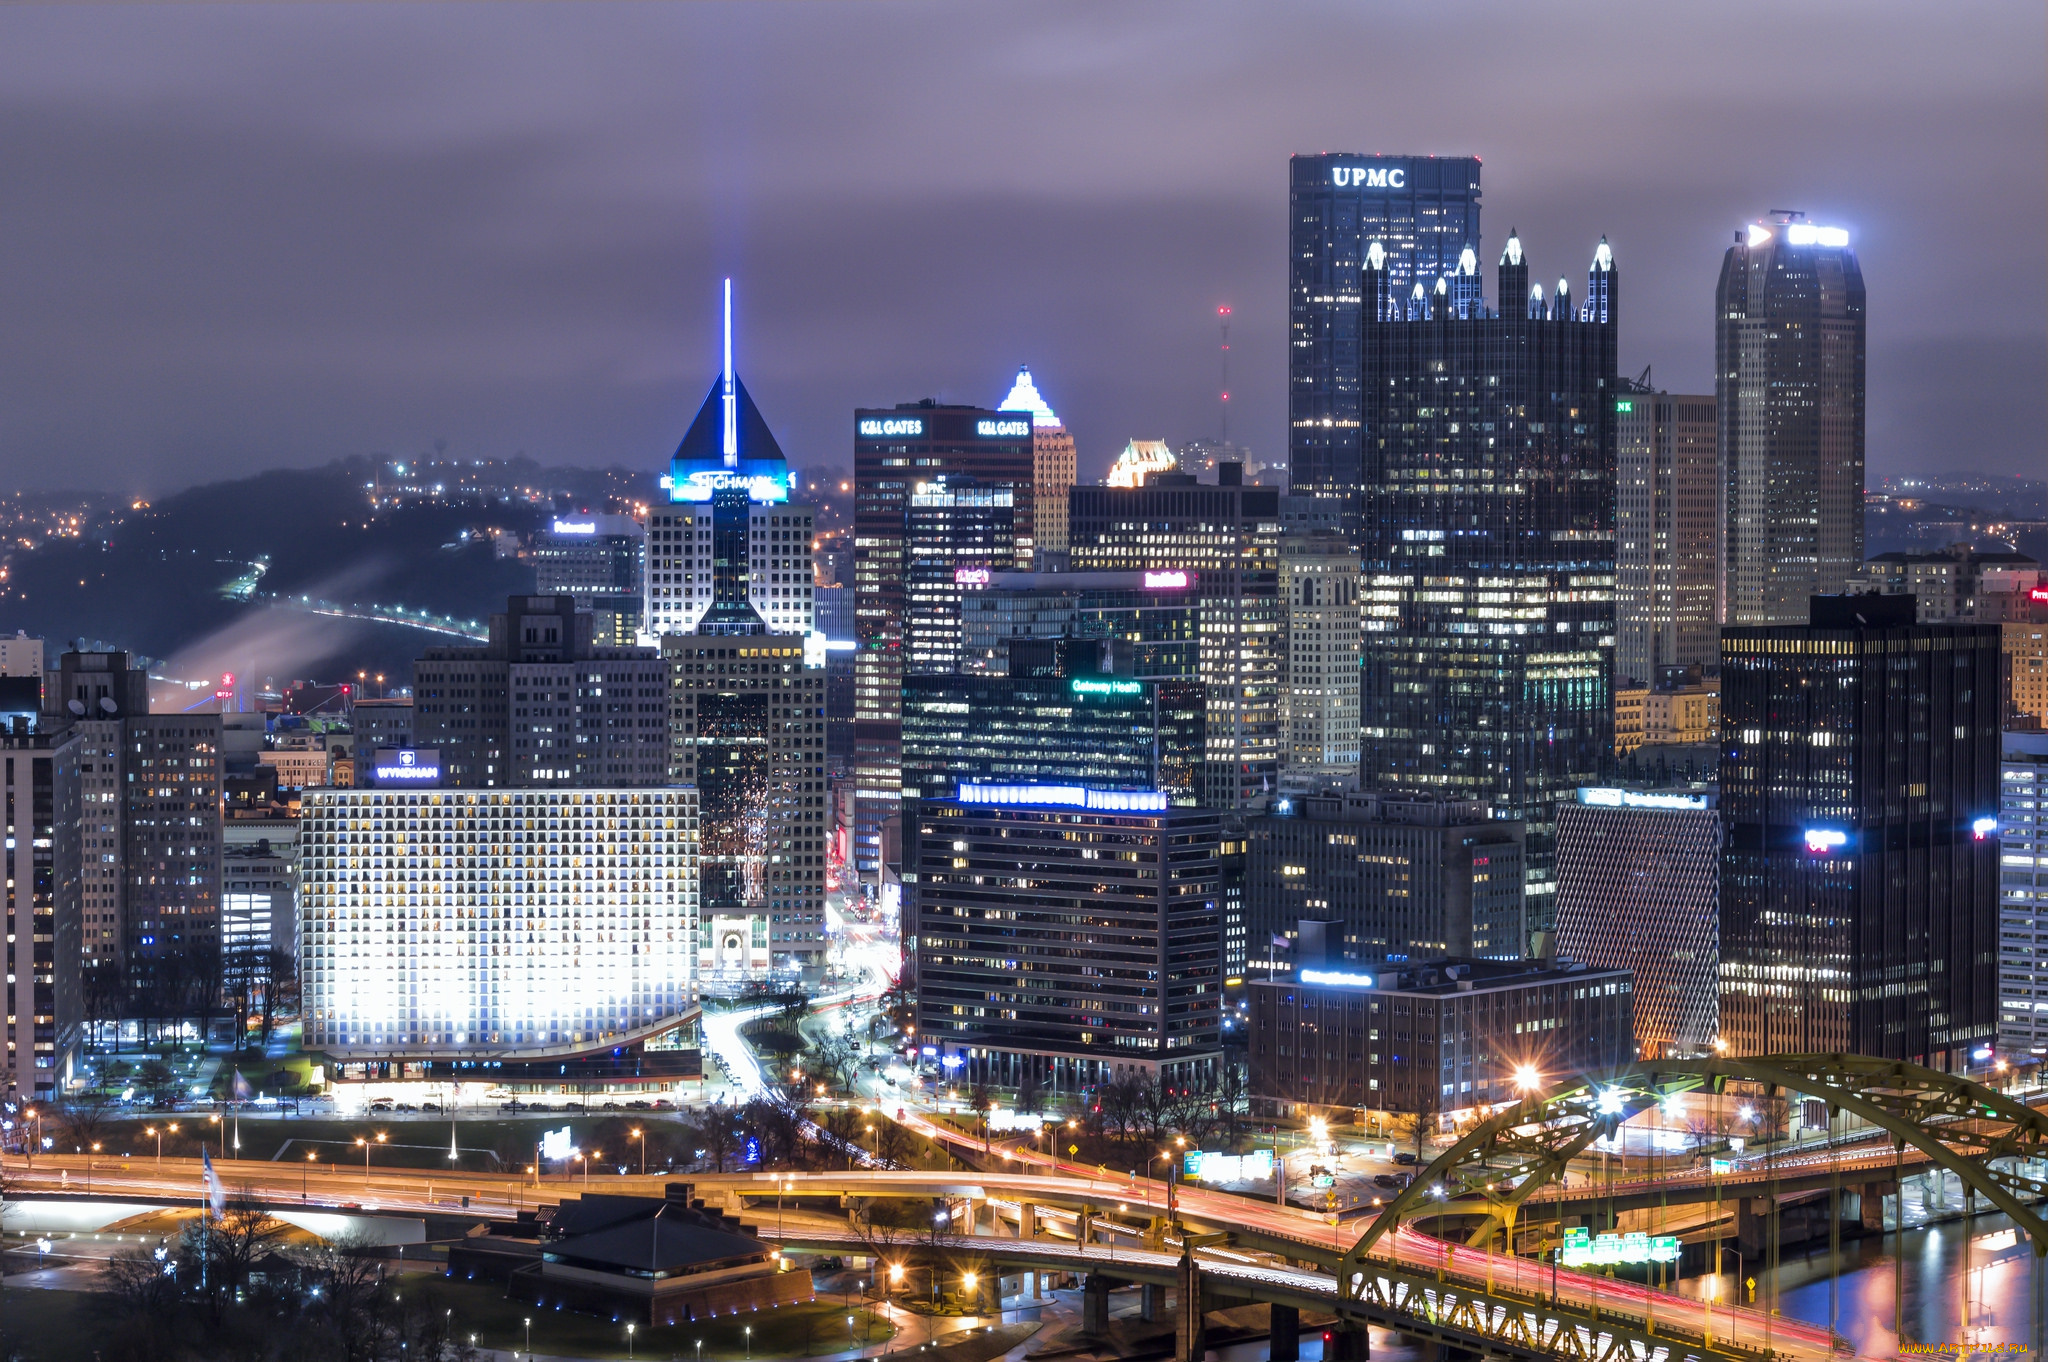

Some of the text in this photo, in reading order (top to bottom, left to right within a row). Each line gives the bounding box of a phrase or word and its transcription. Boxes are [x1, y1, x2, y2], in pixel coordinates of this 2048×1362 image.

[1332, 167, 1405, 188] UPMC
[1617, 402, 1632, 412] NK
[861, 420, 922, 434] K&L GATES
[978, 421, 1029, 435] K&L GATES
[927, 483, 946, 494] PNC
[1073, 680, 1141, 695] Gateway Health
[377, 767, 438, 778] WYNDHAM
